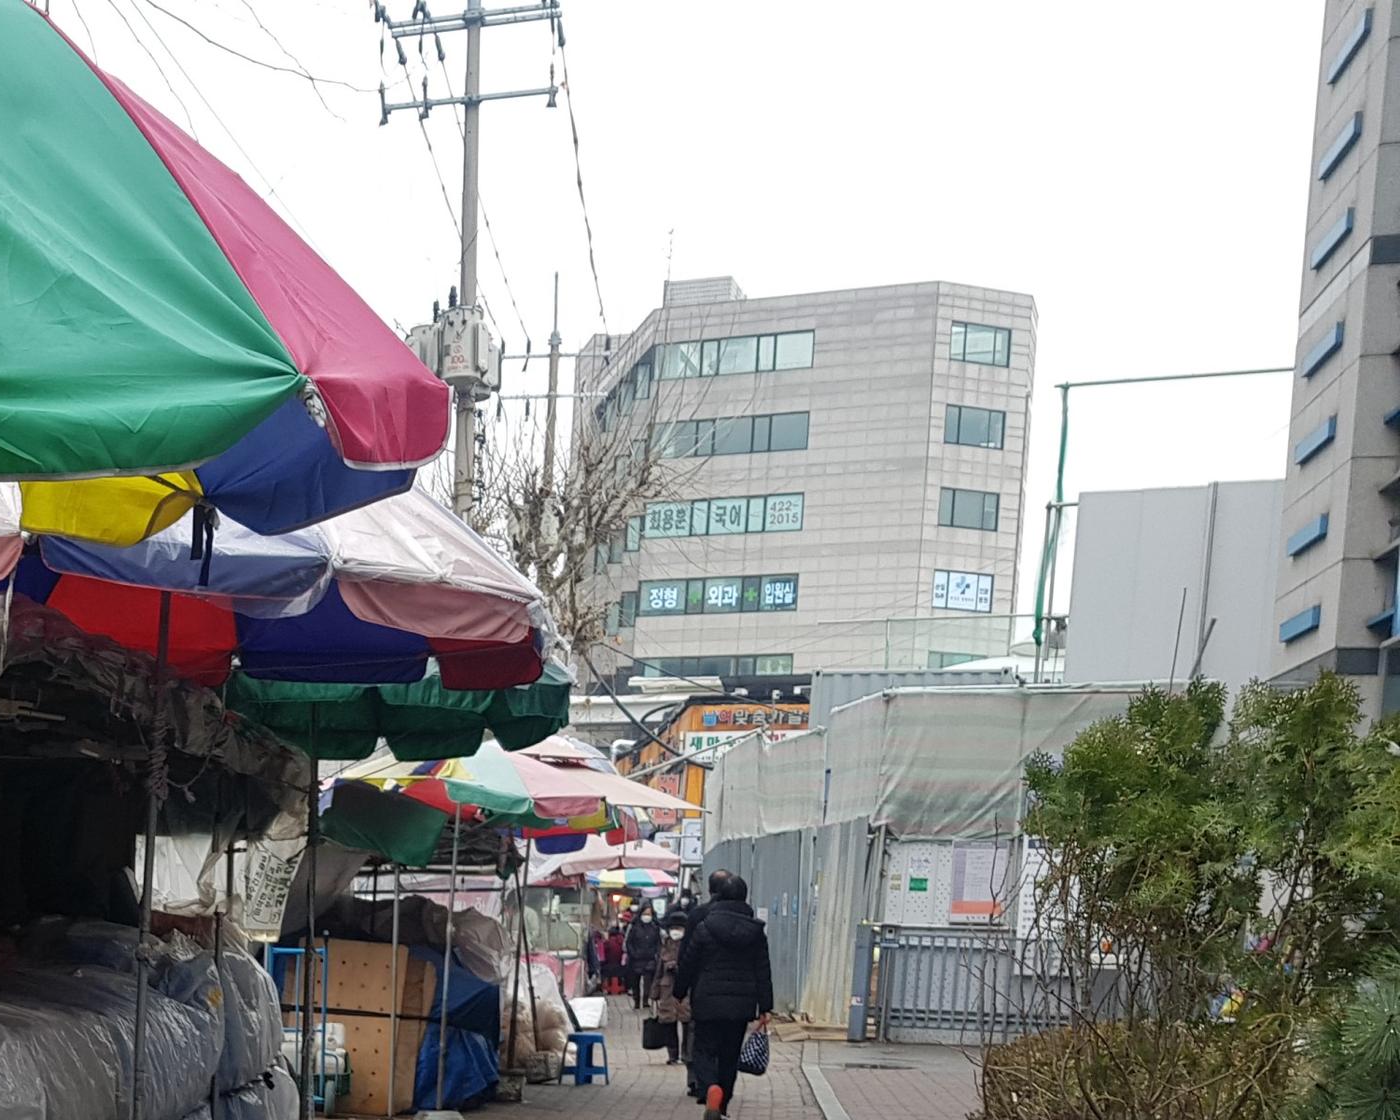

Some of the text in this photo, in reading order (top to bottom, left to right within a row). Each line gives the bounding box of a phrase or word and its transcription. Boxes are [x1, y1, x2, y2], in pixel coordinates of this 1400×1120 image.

[769, 501, 799, 512] 422-
[715, 505, 742, 527] 국어
[769, 512, 799, 525] 2015
[649, 581, 795, 609] 정형 외과 입원실
